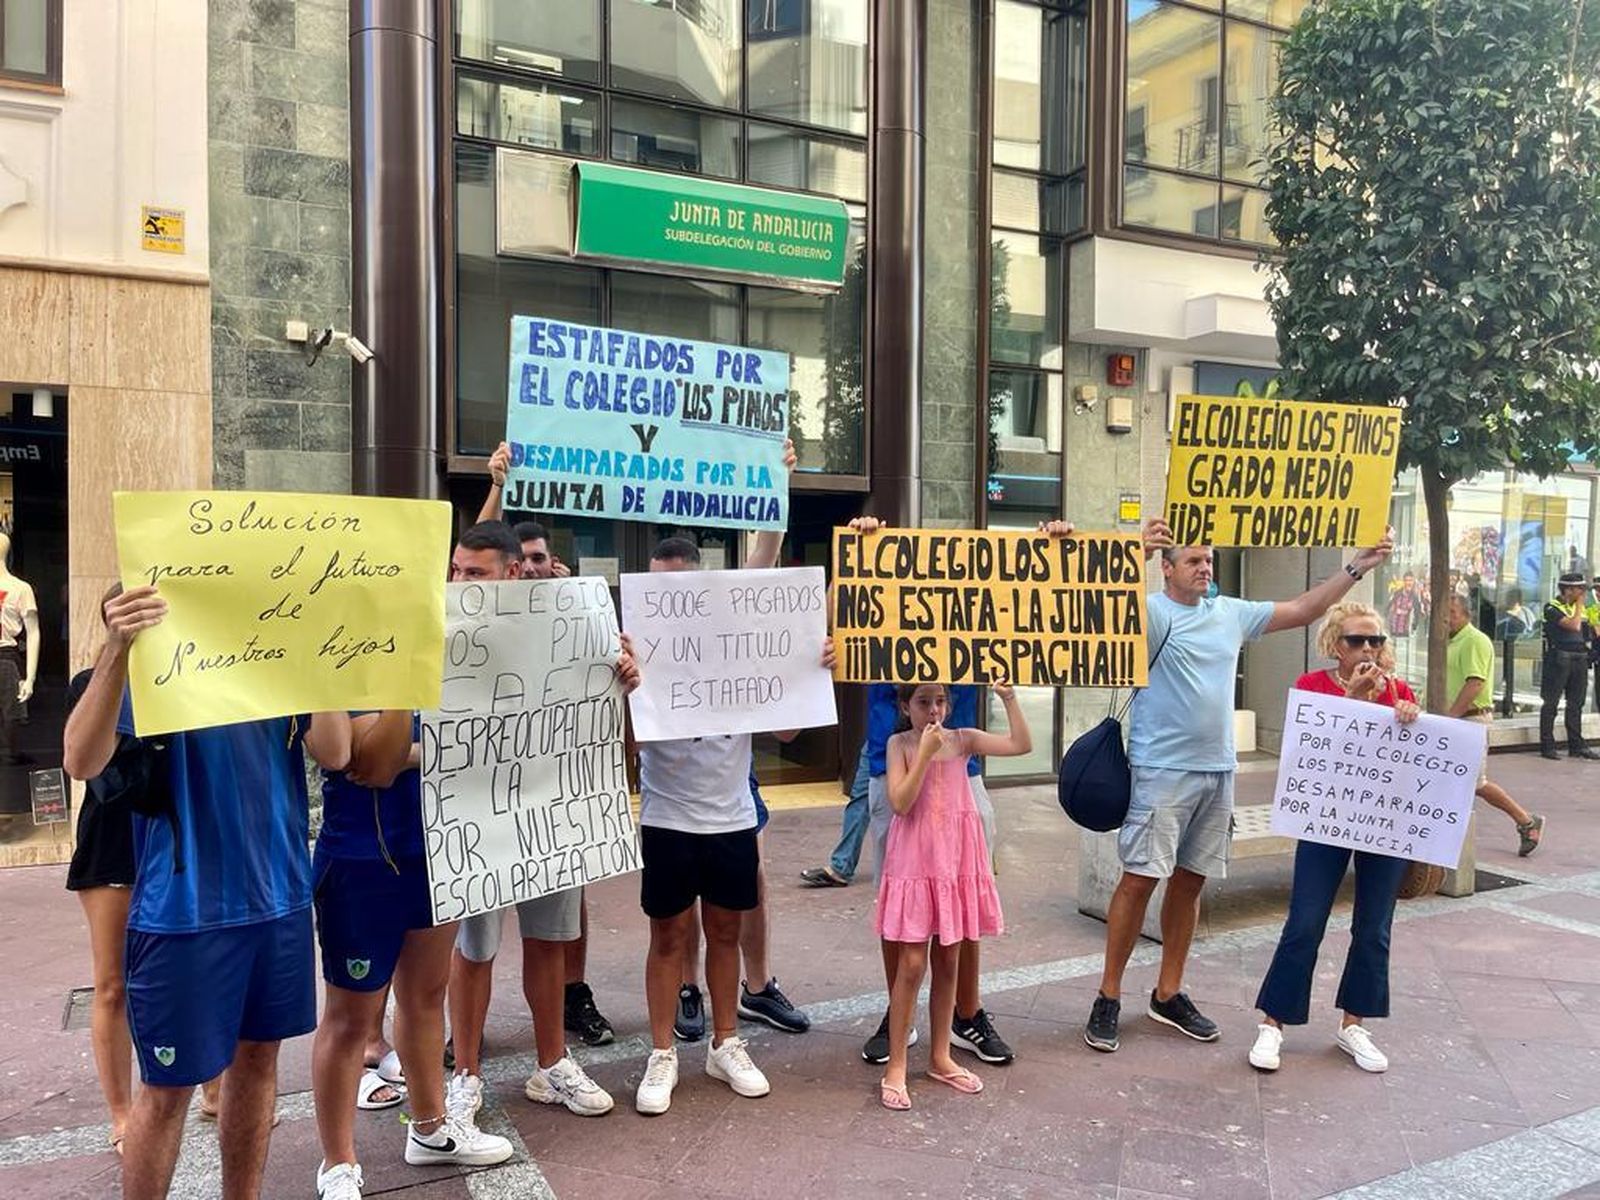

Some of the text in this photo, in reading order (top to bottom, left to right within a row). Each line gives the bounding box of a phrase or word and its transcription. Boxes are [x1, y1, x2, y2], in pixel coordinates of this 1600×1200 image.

[670, 201, 834, 243] JUNTA DE ANDALUCIA
[664, 228, 832, 261] SUBDELEGACIÓN DEL GOBIERNO
[529, 321, 763, 385] ESTAFADOS POR
[519, 363, 554, 406] EL
[564, 370, 676, 417] COLEGIO
[631, 423, 659, 453] Y
[1297, 409, 1338, 453] LOS
[509, 441, 773, 489] DESAMPARADOS POR LA
[1187, 454, 1275, 499] GRADO
[189, 499, 362, 535] Solución
[506, 480, 780, 522] JUNTA DE ANDALUCIA
[145, 546, 402, 595] para el futuro
[999, 537, 1050, 582] LOS
[259, 593, 303, 621] de
[446, 582, 609, 616] OLEGIO
[644, 585, 822, 619] 5000€ PAGADOS
[836, 584, 885, 630] NOS
[1050, 588, 1142, 635] JUNTA
[154, 625, 396, 686] Nuestros hijos
[450, 625, 489, 667] OS
[644, 629, 791, 664] Y UN TITULO
[671, 675, 783, 710] ESTAFADO
[422, 697, 623, 777] DESPREOCUPACION
[1295, 703, 1449, 751] ESTAFADOS
[1298, 757, 1431, 793] LOS PINOS Y
[1300, 732, 1468, 776] POR EL COLEGIO
[422, 740, 625, 831] DE LA JUNTA
[1286, 777, 1458, 825] DESAMPARADOS
[426, 790, 634, 882] POR NUESTRA
[1279, 797, 1432, 838] POR LA JUNTA DE
[1304, 822, 1414, 855] ANDALUCIA
[434, 834, 641, 923] ESCOLARIZACION
